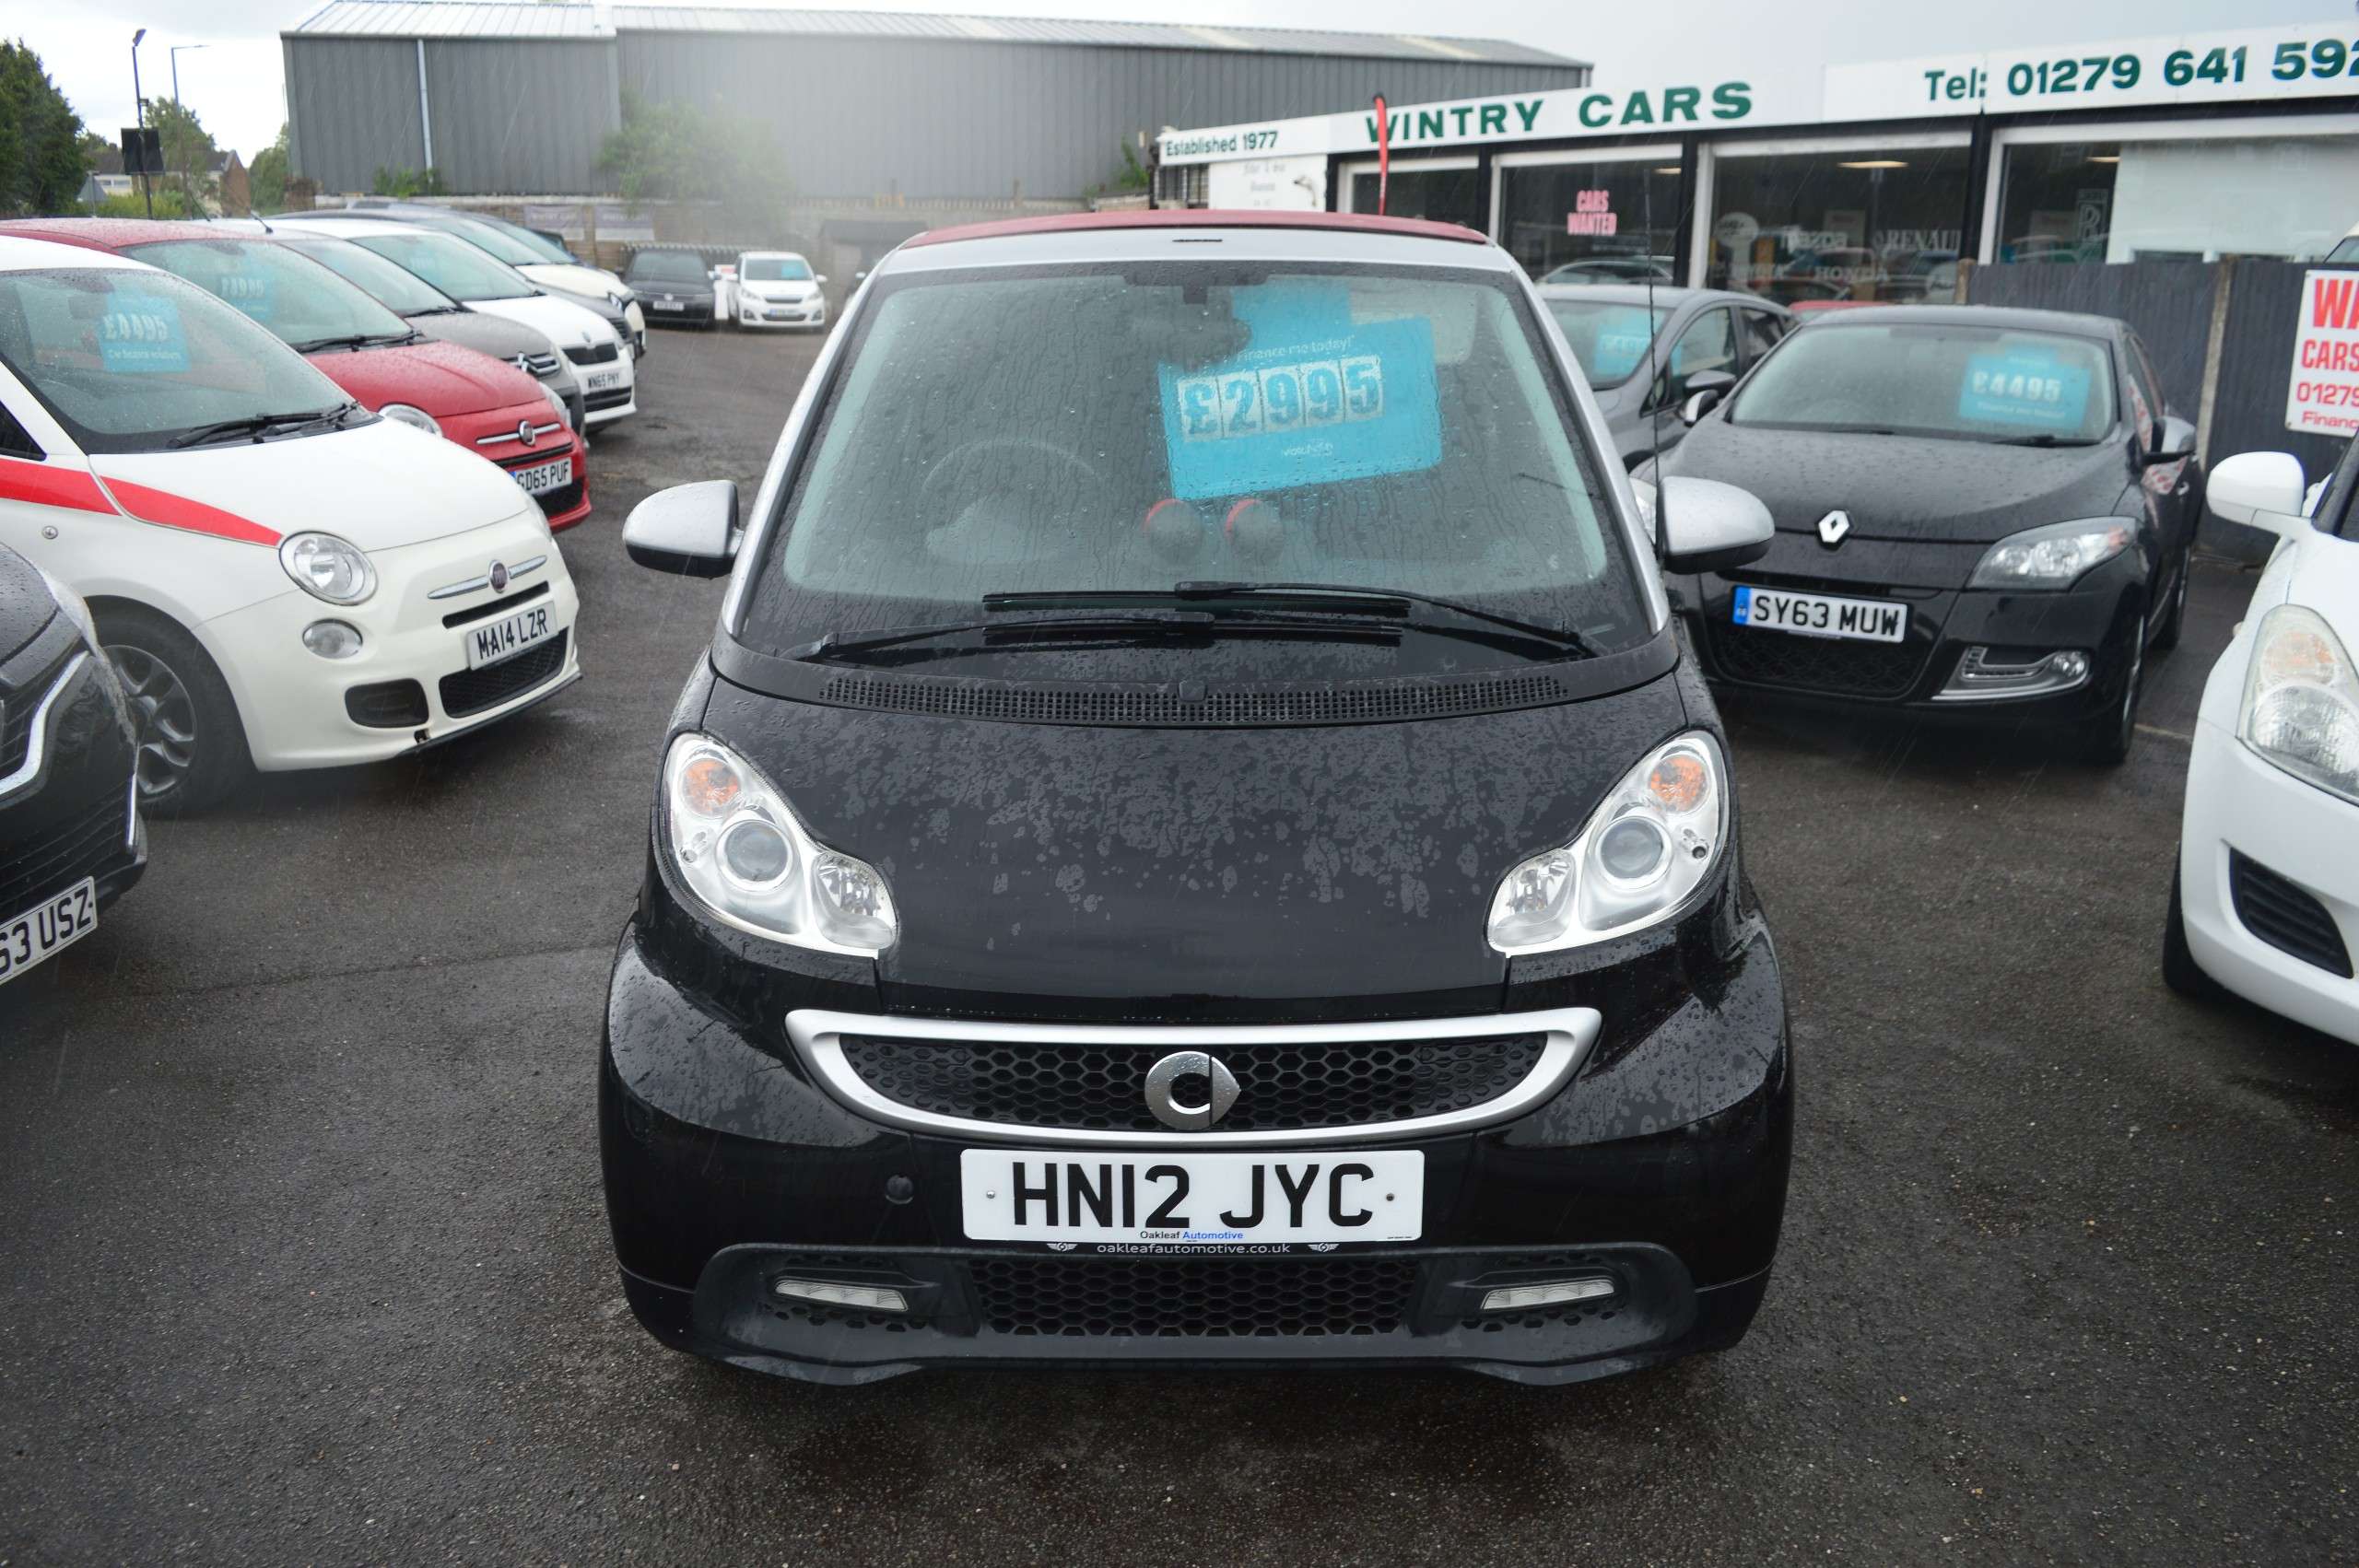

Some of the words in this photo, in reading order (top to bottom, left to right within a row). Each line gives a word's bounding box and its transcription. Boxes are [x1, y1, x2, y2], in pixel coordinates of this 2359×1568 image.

[1925, 65, 1987, 101] Tel:
[2007, 53, 2141, 97] 01279
[2164, 45, 2248, 87] 641
[2271, 38, 2359, 81] 59
[1366, 99, 1543, 144] WINTRY
[1579, 82, 1753, 127] CARS
[1166, 136, 1238, 157] Established
[1243, 131, 1278, 151] 1977
[1576, 190, 1610, 213] CARS
[1567, 212, 1617, 237] WANTED
[1182, 363, 1380, 435] £2995
[1972, 371, 2062, 402] £4495
[517, 467, 547, 491] GD65
[550, 461, 569, 485] PUF
[517, 608, 548, 643] LZR
[1755, 595, 1829, 628] SY63
[1838, 603, 1899, 636] MUW
[38, 885, 91, 951] USZ
[1218, 1163, 1375, 1228] JYC
[1097, 1242, 1290, 1254] oakleafautomotive.co.uk
[1140, 1230, 1180, 1240] Oakleaf
[1182, 1230, 1244, 1240] Automotive
